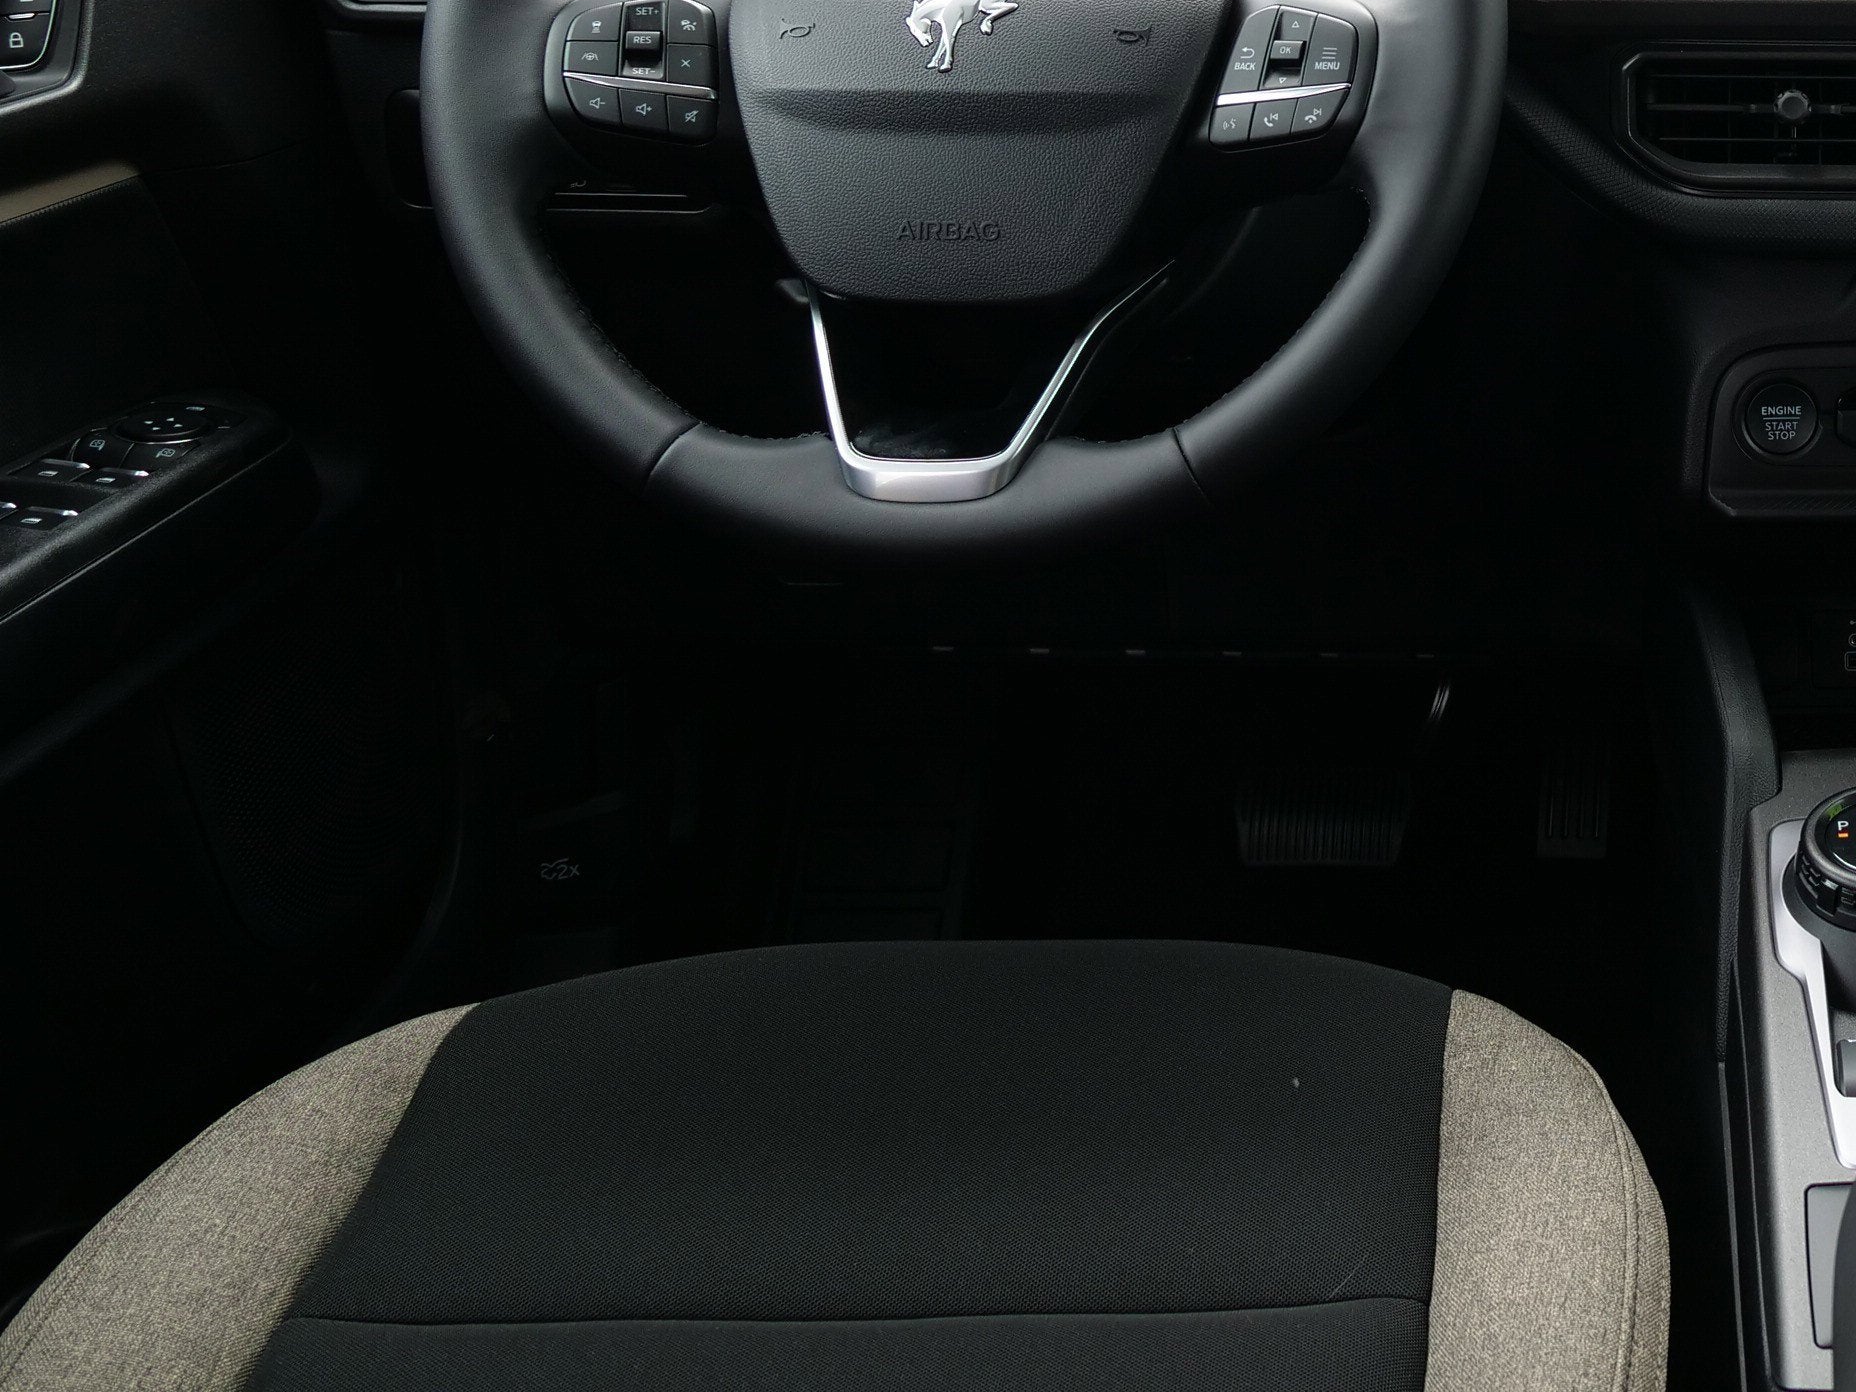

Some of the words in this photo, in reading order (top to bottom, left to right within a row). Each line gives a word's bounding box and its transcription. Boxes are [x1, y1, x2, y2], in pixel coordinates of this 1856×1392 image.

[635, 6, 660, 16] SET+
[633, 35, 651, 45] RES
[1279, 46, 1292, 54] OK
[1234, 62, 1256, 71] BACK
[1314, 61, 1340, 70] MENU
[899, 220, 1001, 242] AIRBAG
[1761, 405, 1802, 416] ENGINE
[1765, 421, 1799, 431] START
[1768, 430, 1796, 440] STOP
[1837, 820, 1850, 831] P
